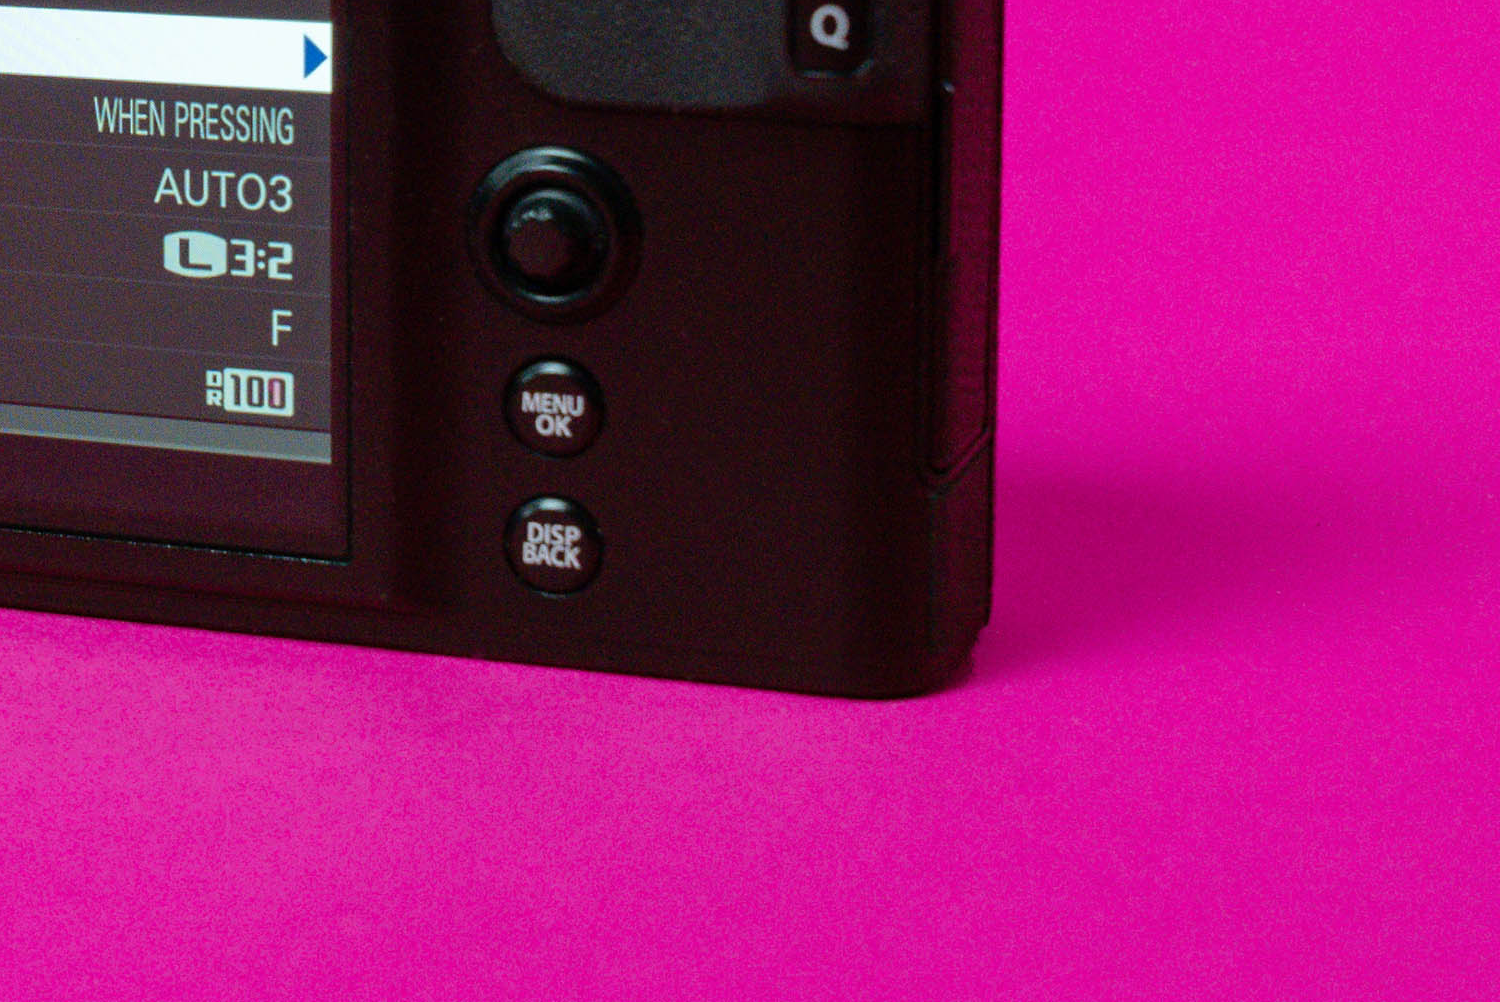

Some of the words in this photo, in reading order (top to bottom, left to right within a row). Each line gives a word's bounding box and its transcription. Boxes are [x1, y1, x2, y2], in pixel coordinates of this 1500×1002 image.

[809, 3, 851, 51] Q
[94, 96, 165, 137] WHEN
[175, 103, 295, 145] PRESSING
[154, 168, 294, 212] AUTO3
[271, 309, 293, 346] F
[230, 373, 287, 410] 100
[522, 390, 585, 418] MENU
[534, 414, 573, 439] OK
[526, 521, 582, 544] DISP
[521, 542, 582, 570] BACK
